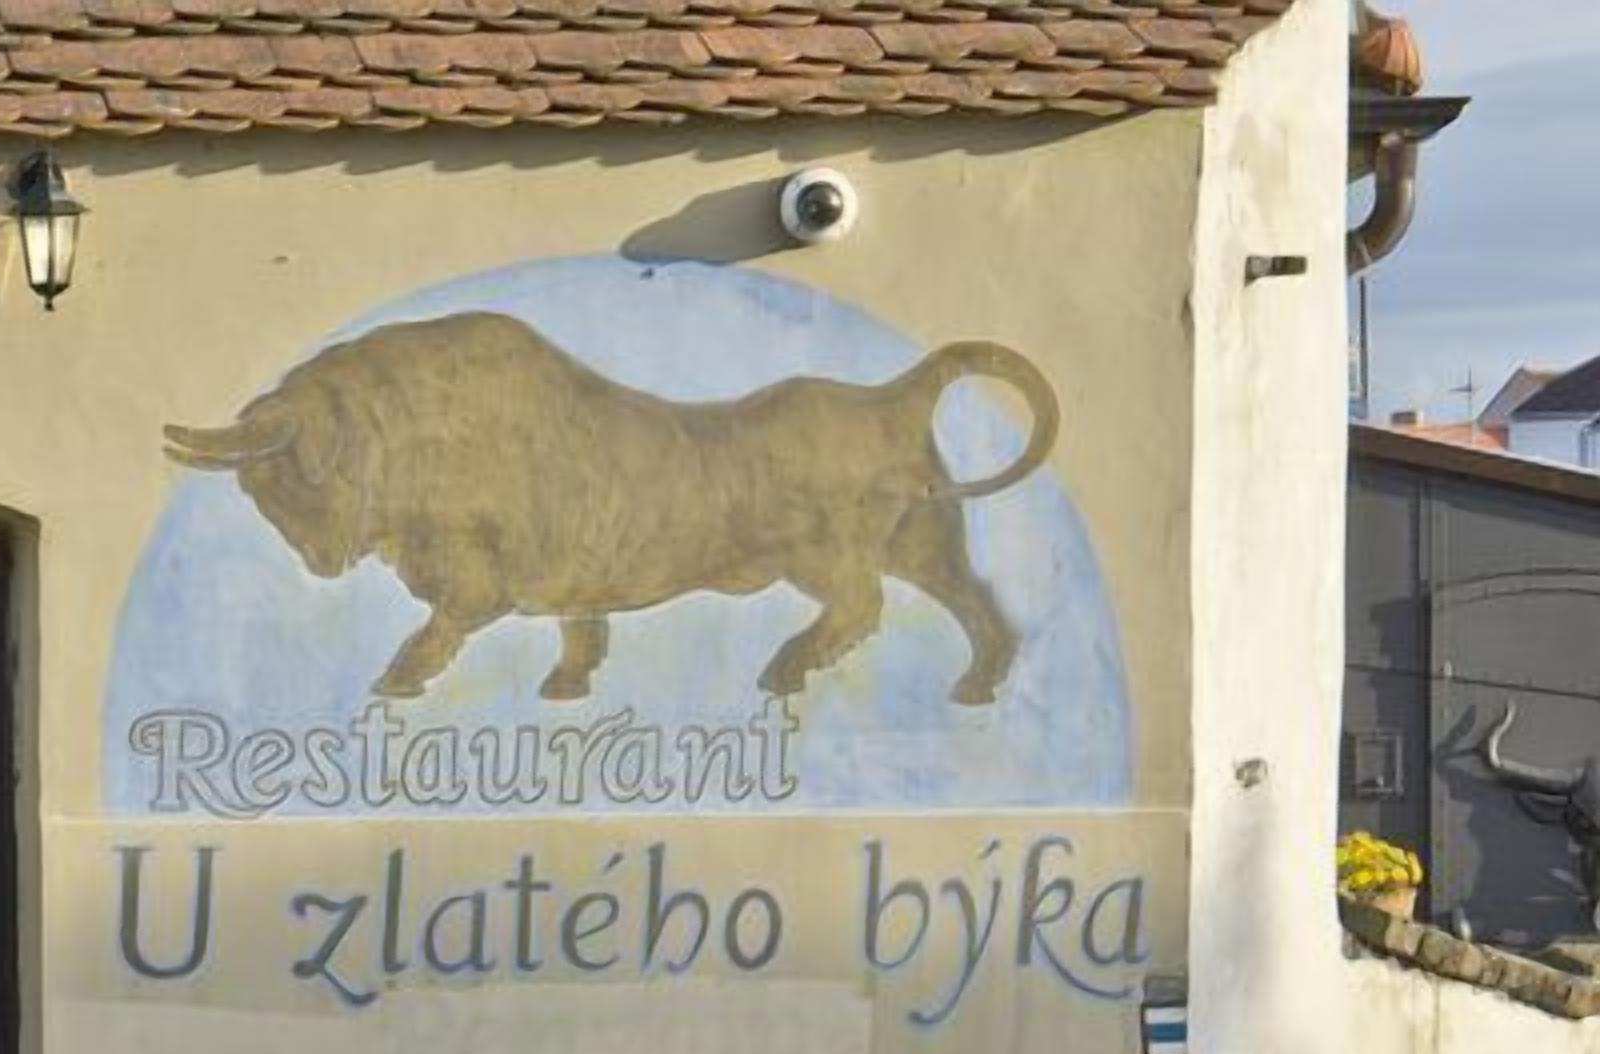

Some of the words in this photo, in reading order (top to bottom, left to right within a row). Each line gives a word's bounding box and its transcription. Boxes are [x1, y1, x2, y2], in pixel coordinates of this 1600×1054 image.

[128, 694, 799, 819] Restaurant
[113, 846, 224, 980] U
[287, 841, 783, 1008] zlatého
[862, 834, 1150, 1031] býka
